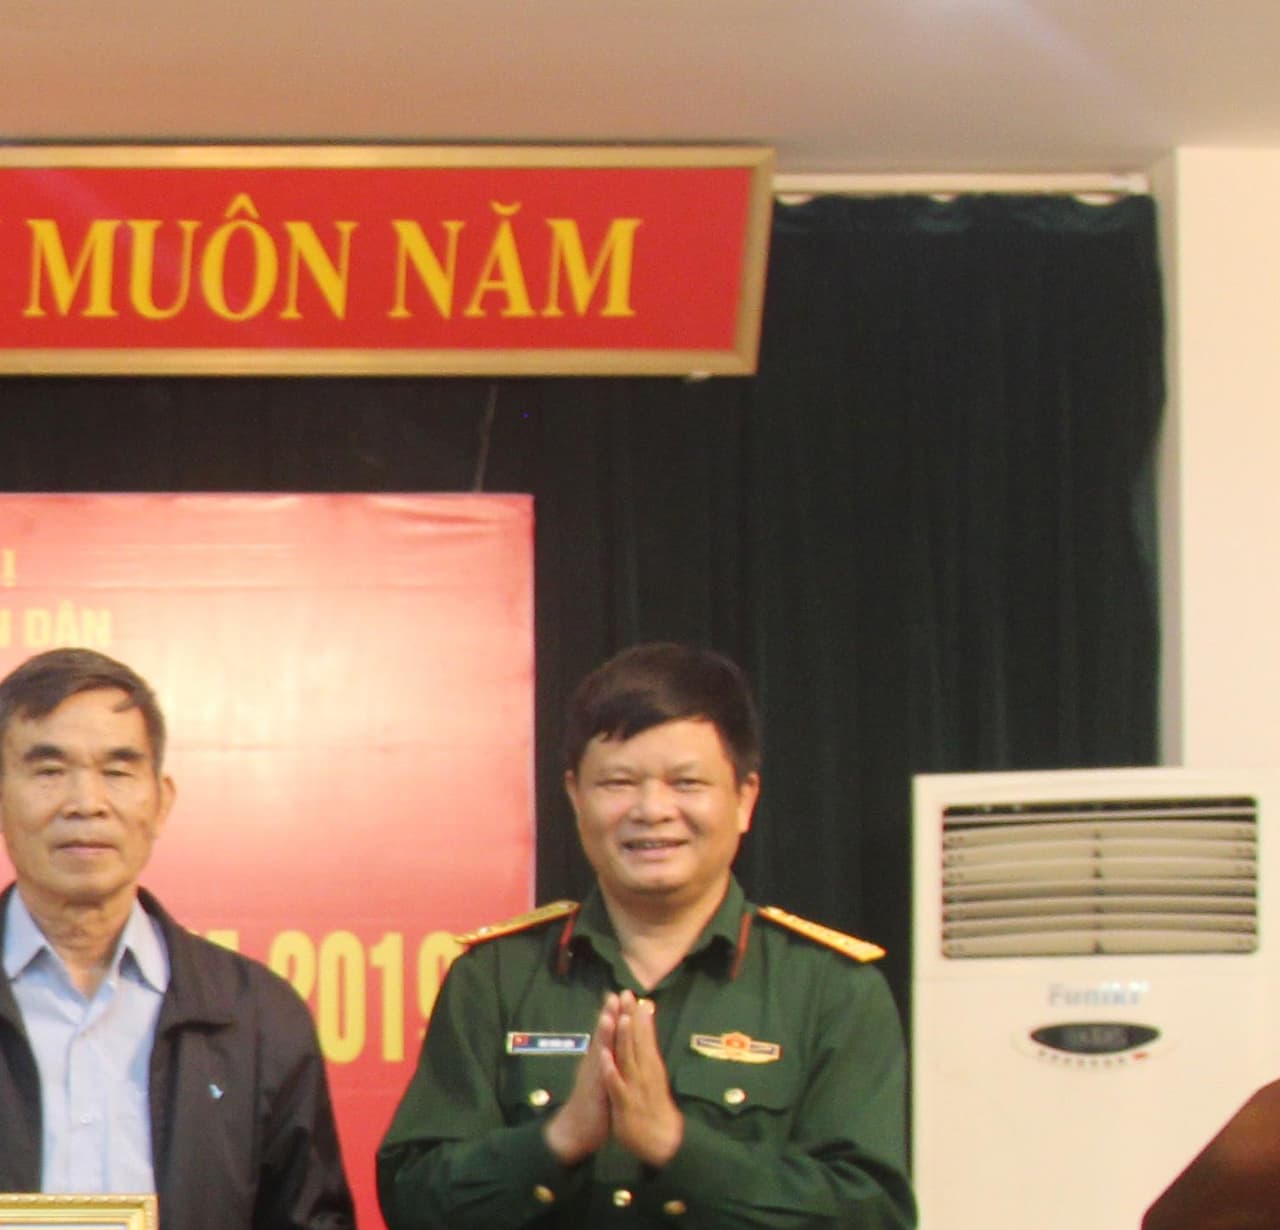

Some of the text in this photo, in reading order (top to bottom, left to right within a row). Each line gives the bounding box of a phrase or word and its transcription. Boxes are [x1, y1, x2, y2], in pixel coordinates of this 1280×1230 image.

[24, 194, 357, 320] MUÔN
[389, 202, 641, 318] NĂM
[23, 600, 112, 648] DÂN
